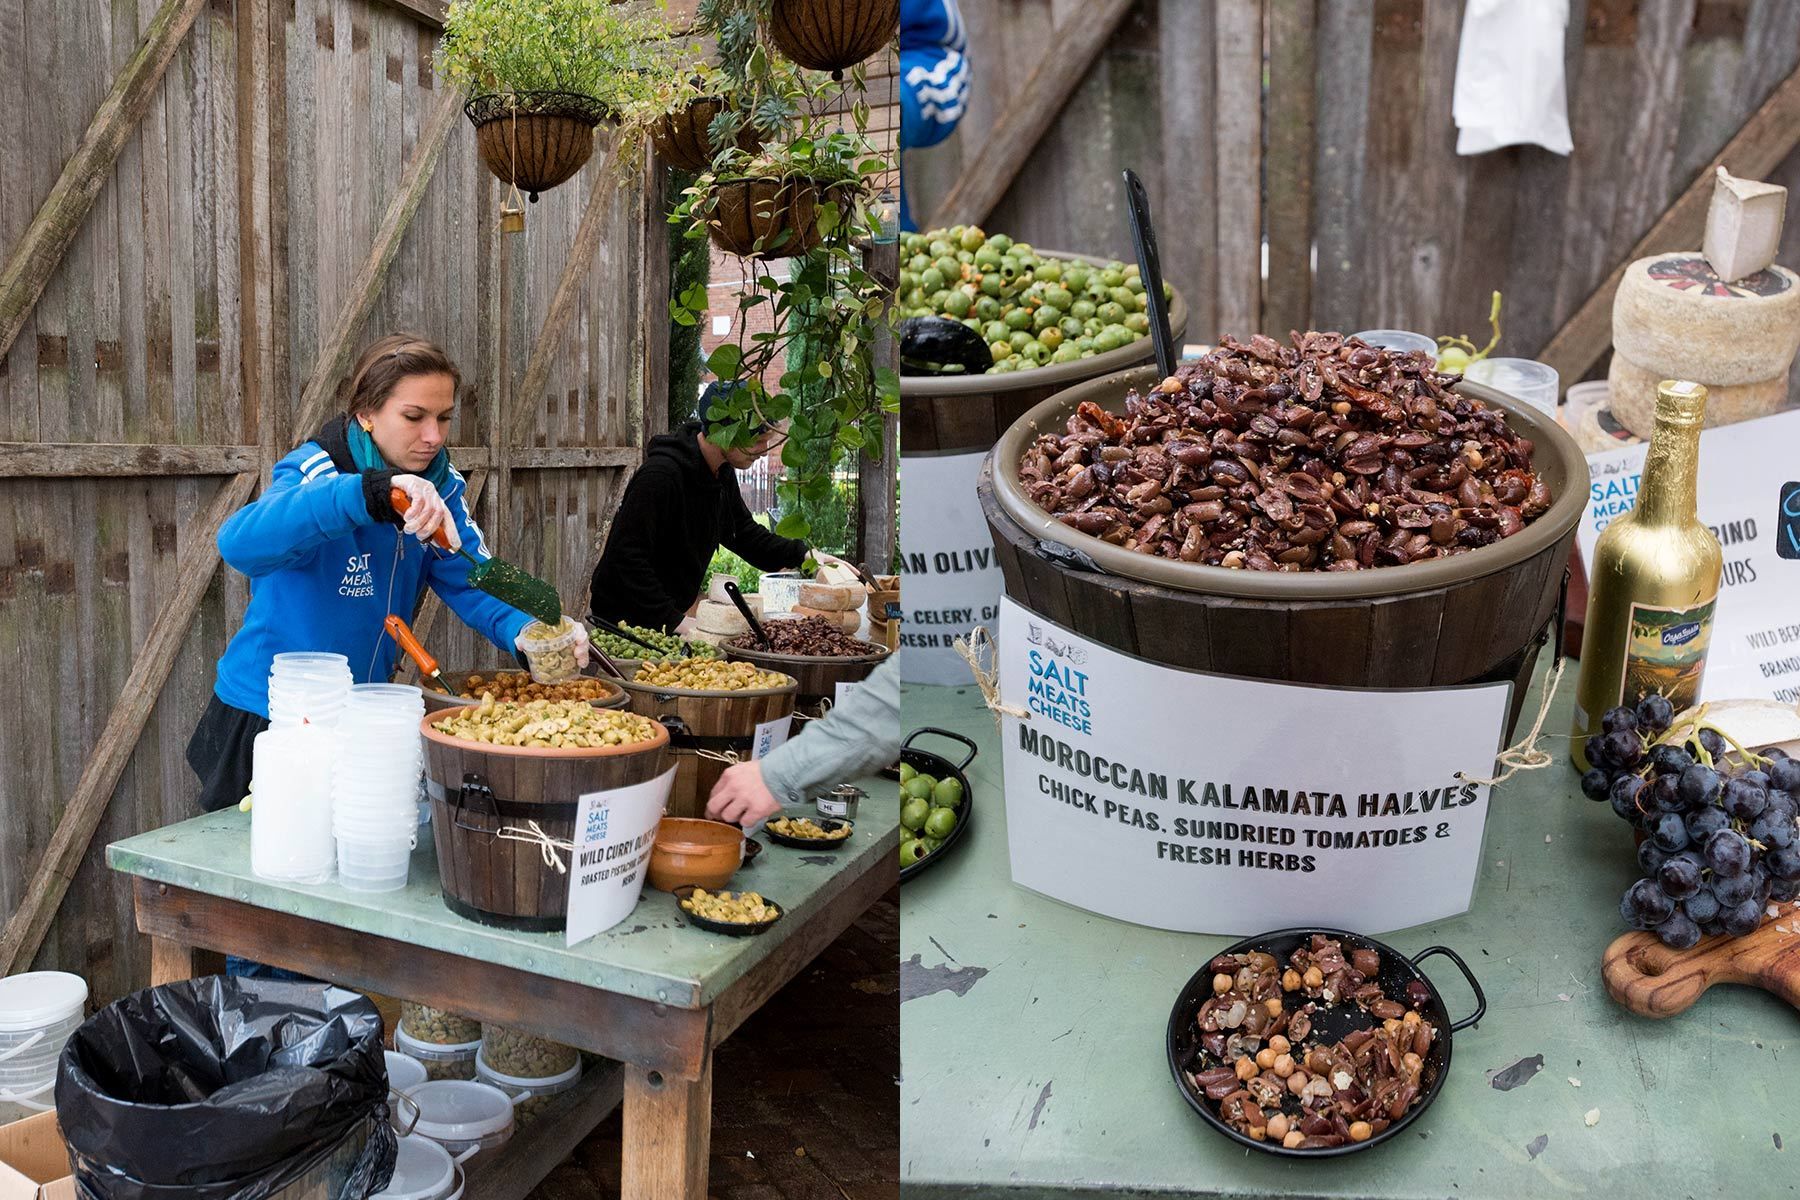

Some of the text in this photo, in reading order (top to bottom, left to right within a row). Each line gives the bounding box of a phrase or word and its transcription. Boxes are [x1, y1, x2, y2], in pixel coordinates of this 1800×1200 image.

[1591, 474, 1642, 502] SALT
[1719, 558, 1757, 589] URS
[338, 585, 374, 597] CHEESE
[1746, 630, 1778, 650] WILD
[1028, 649, 1089, 697] SALT
[1028, 676, 1091, 718] MEATS
[1028, 696, 1092, 736] CHEESE
[1018, 722, 1480, 818] MOROCCAN KALAMATA HALVES
[587, 809, 610, 824] SALT
[1038, 774, 1098, 815] CHICK
[1173, 817, 1295, 846] SUNDRIED
[1302, 825, 1428, 850] TOMATOES
[1434, 822, 1451, 839] &
[584, 831, 607, 843] CHEESE
[585, 822, 608, 835] MEATS
[579, 847, 605, 869] WILD
[605, 839, 635, 861] CURRY
[1157, 841, 1316, 873] FRESH HERBS
[580, 869, 610, 887] ROASTED
